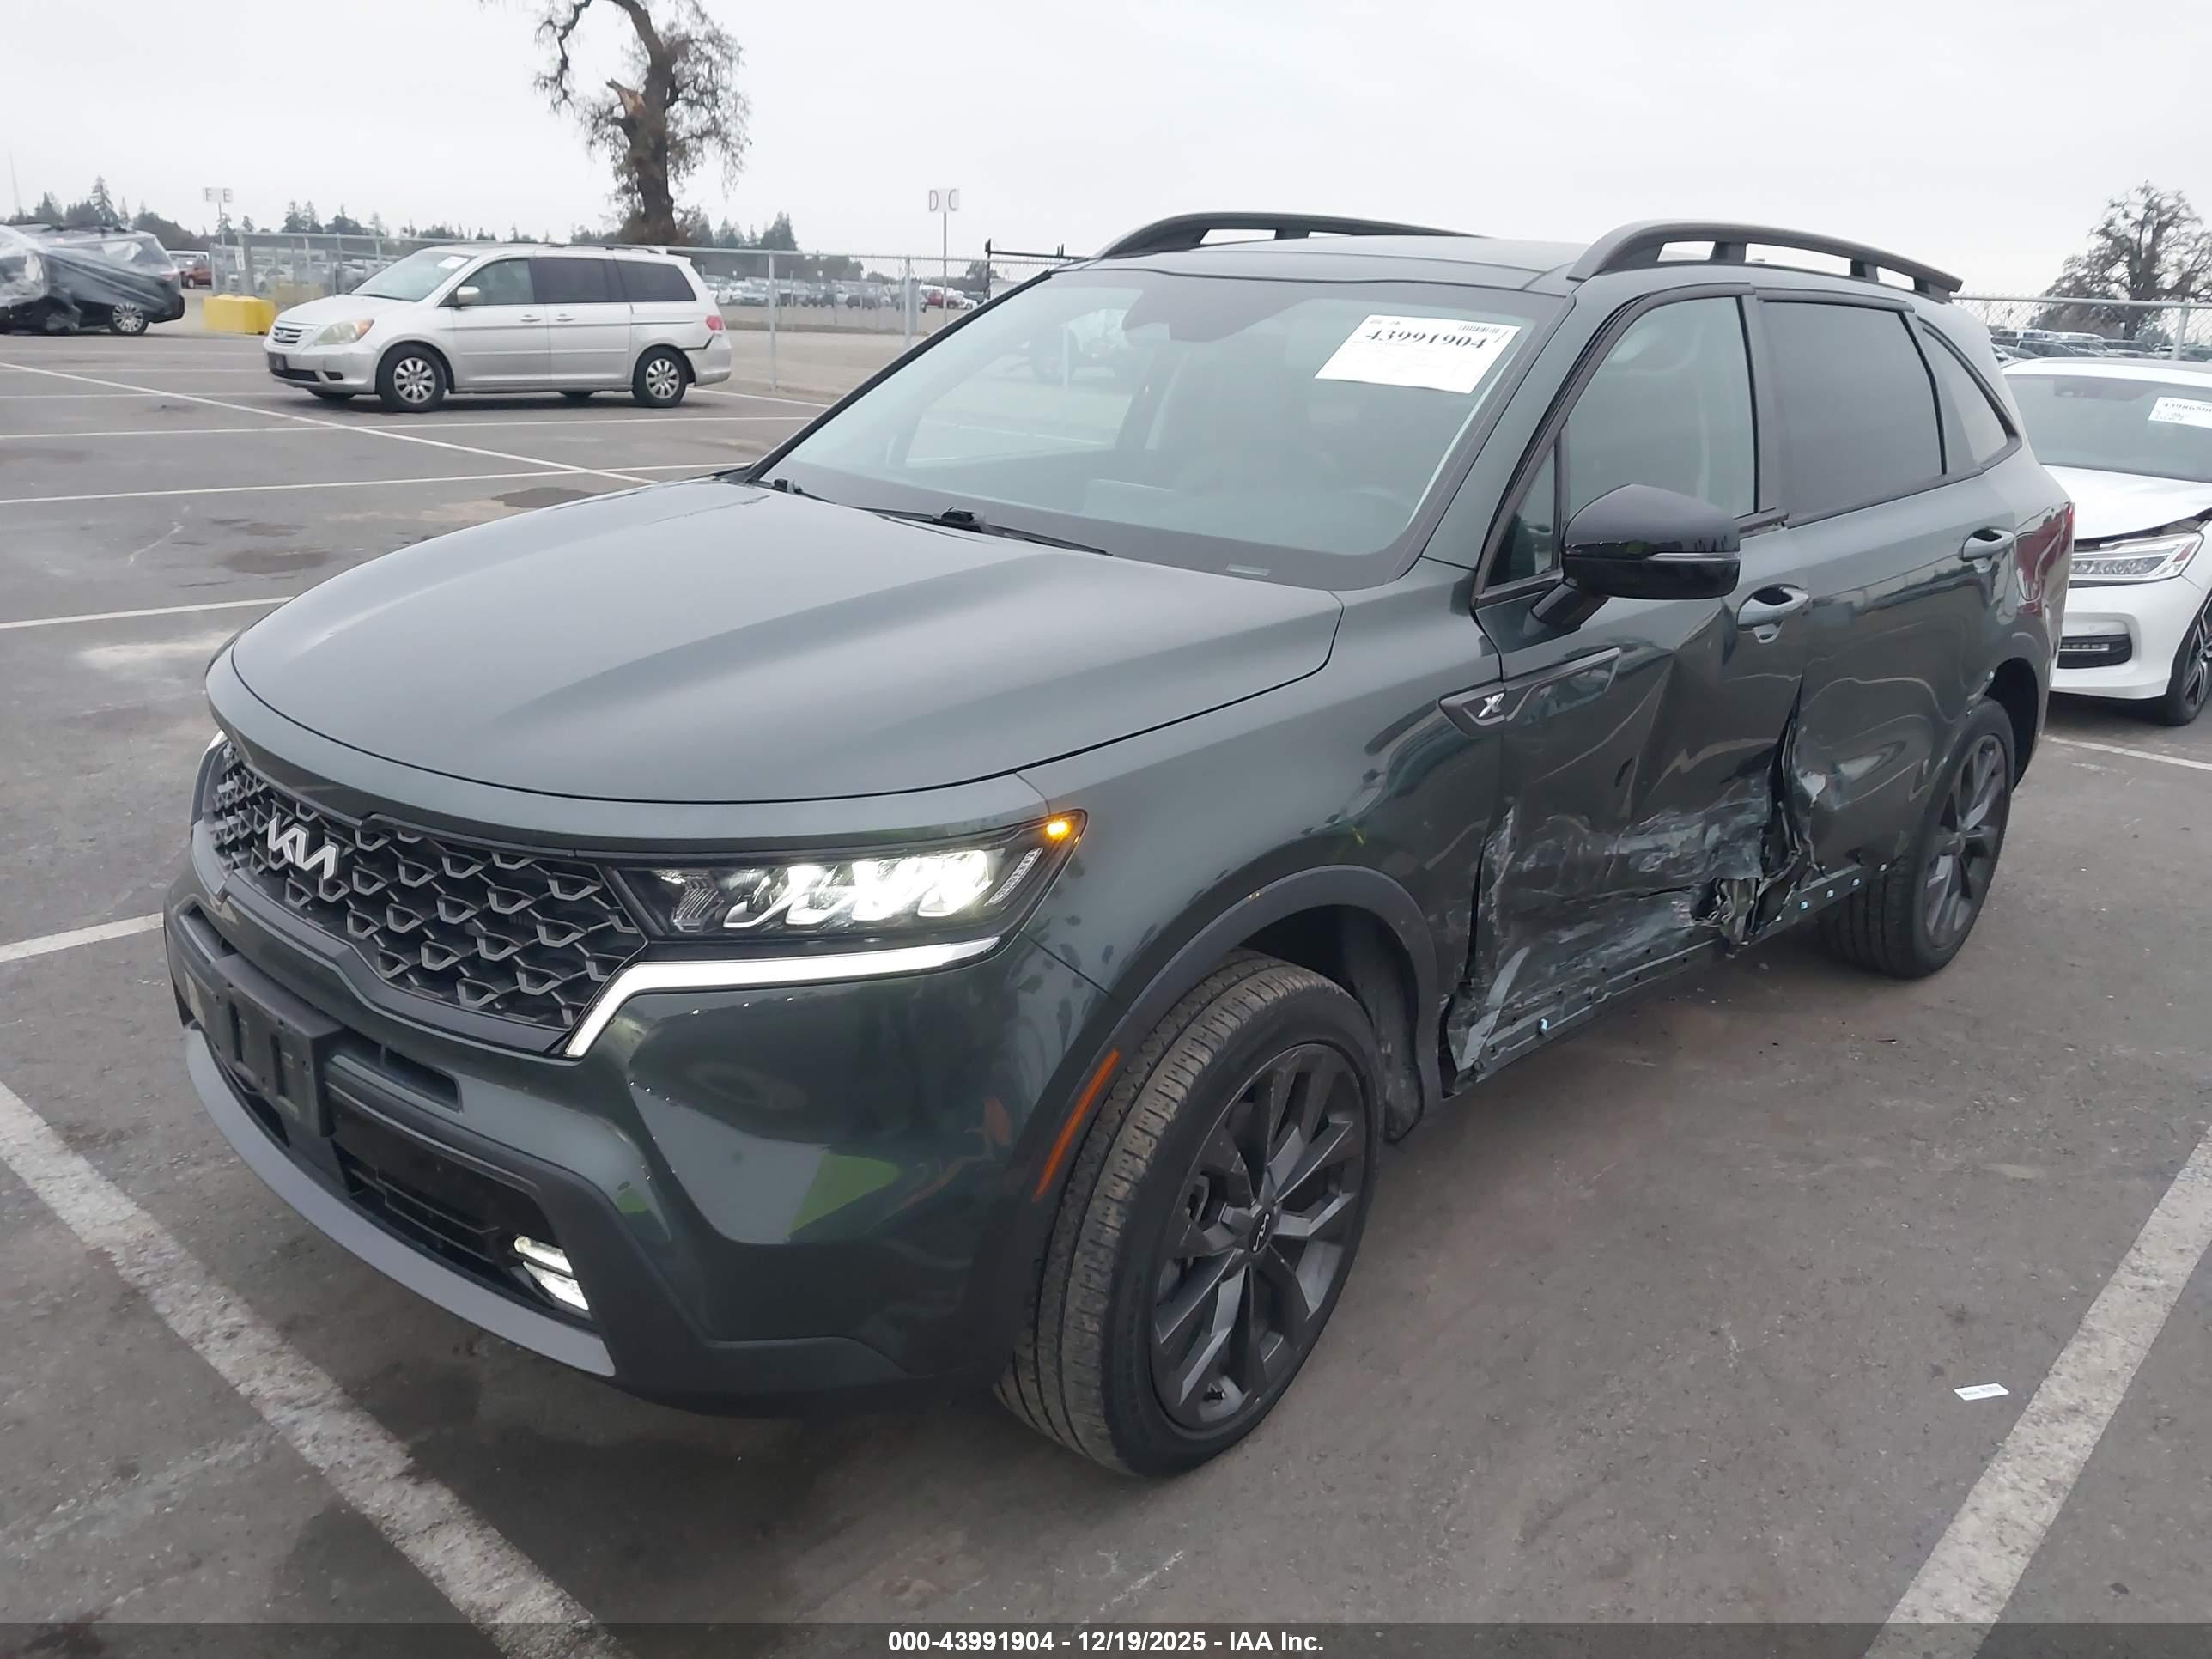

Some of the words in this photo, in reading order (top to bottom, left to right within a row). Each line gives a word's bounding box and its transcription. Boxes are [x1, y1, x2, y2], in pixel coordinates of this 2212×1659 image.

[928, 189, 939, 211] D
[947, 188, 957, 212] C
[1366, 329, 1488, 349] 43991904
[267, 812, 338, 880] KIA
